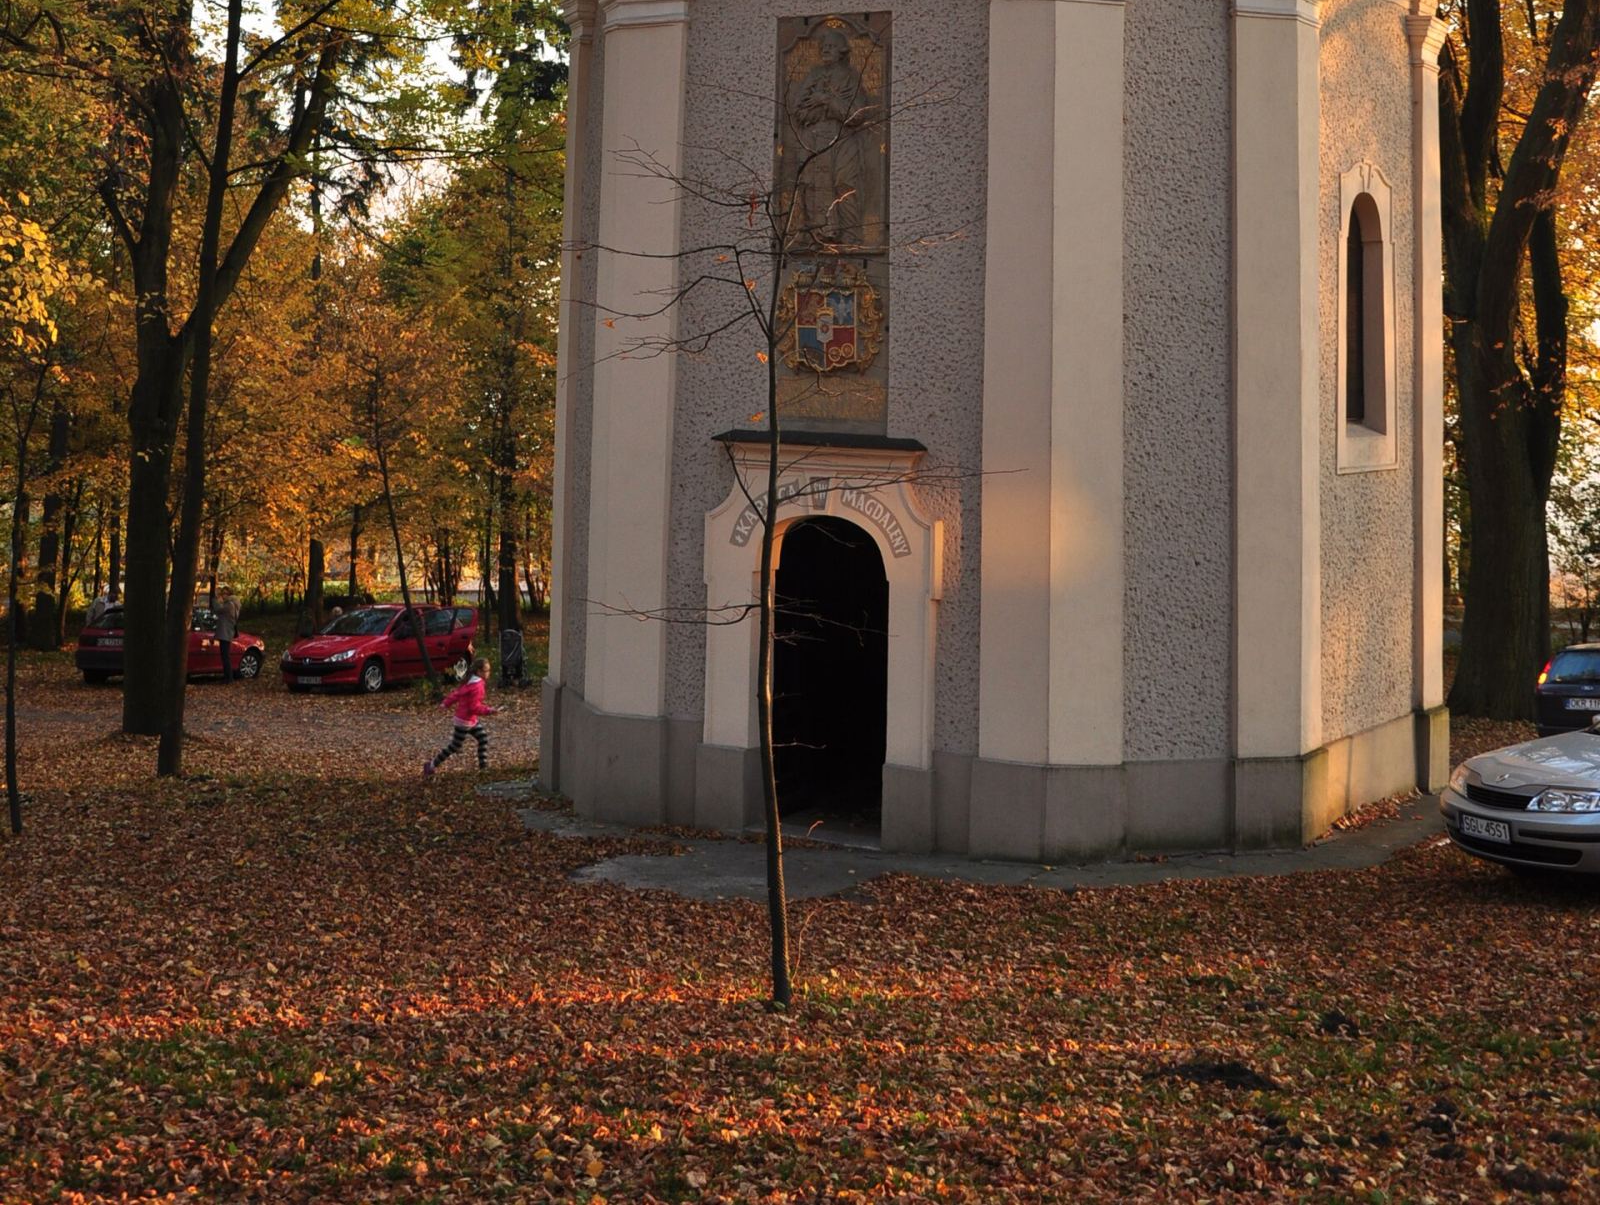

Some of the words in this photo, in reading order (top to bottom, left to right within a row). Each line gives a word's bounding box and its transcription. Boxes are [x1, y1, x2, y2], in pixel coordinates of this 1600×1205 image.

[735, 484, 796, 536] KAPCA
[842, 489, 909, 555] MAGDALENY
[1464, 816, 1482, 833] SGL
